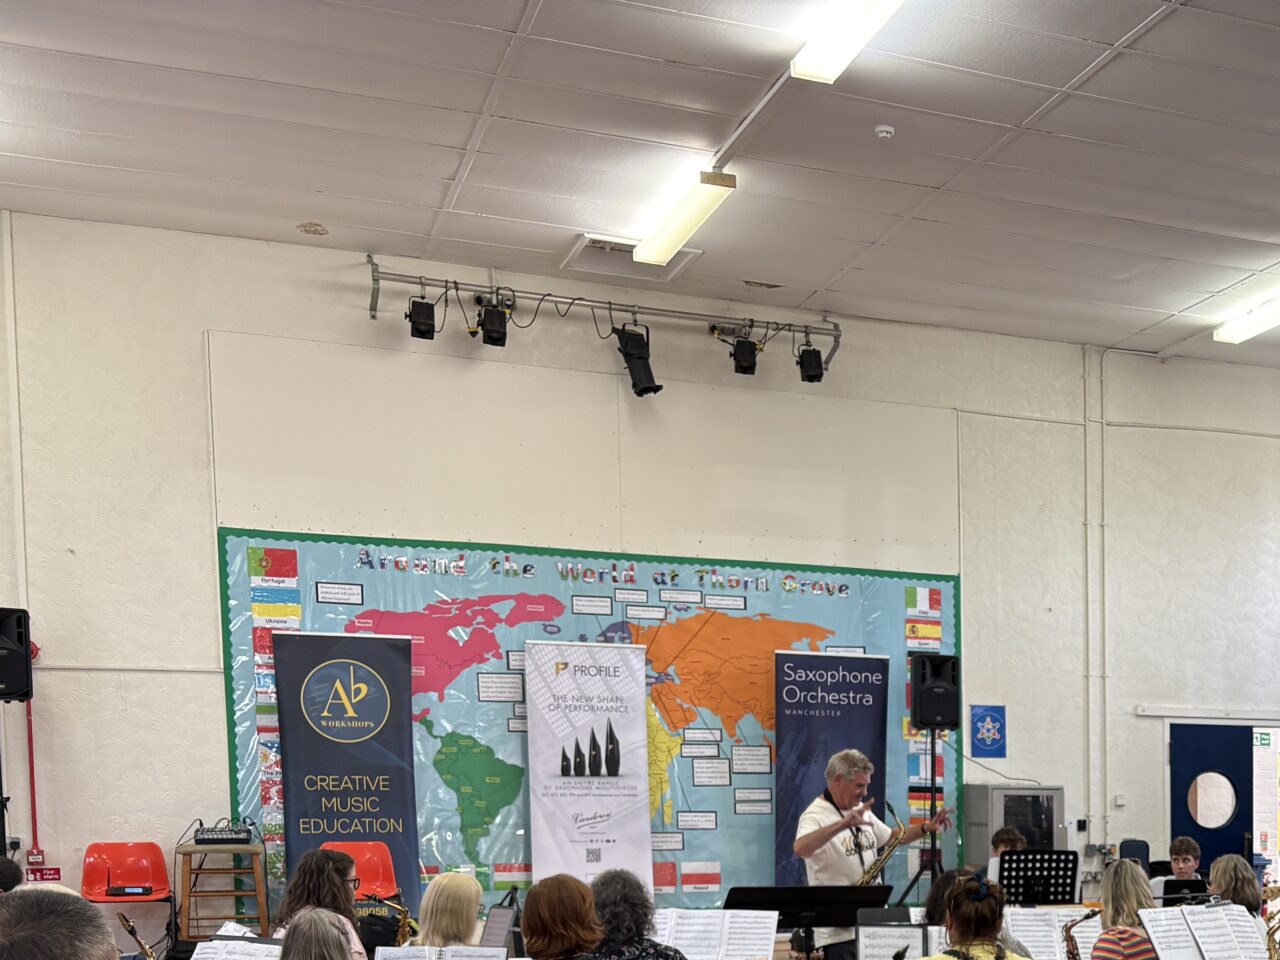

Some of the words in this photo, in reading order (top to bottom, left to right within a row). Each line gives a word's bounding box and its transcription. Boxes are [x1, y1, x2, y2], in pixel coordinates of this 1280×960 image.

[353, 548, 467, 576] Around
[489, 555, 536, 578] the
[556, 561, 637, 584] World
[653, 569, 679, 587] at
[692, 568, 770, 594] Thorn
[781, 574, 851, 598] Grove
[261, 577, 286, 585] Portugal
[573, 664, 621, 678] PROFILE
[783, 662, 883, 686] Saxophone
[552, 694, 569, 703] THE
[571, 695, 594, 704] NEW
[597, 695, 625, 704] SHAPE
[782, 684, 873, 706] Orchestra
[548, 703, 559, 712] OF
[564, 704, 629, 714] PERFORMANCE
[785, 708, 841, 717] MANCHESTER
[320, 719, 375, 728] WORKSHOPS
[304, 774, 390, 791] CREATIVE
[321, 796, 380, 813] MUSIC
[299, 817, 403, 835] EDUCATION
